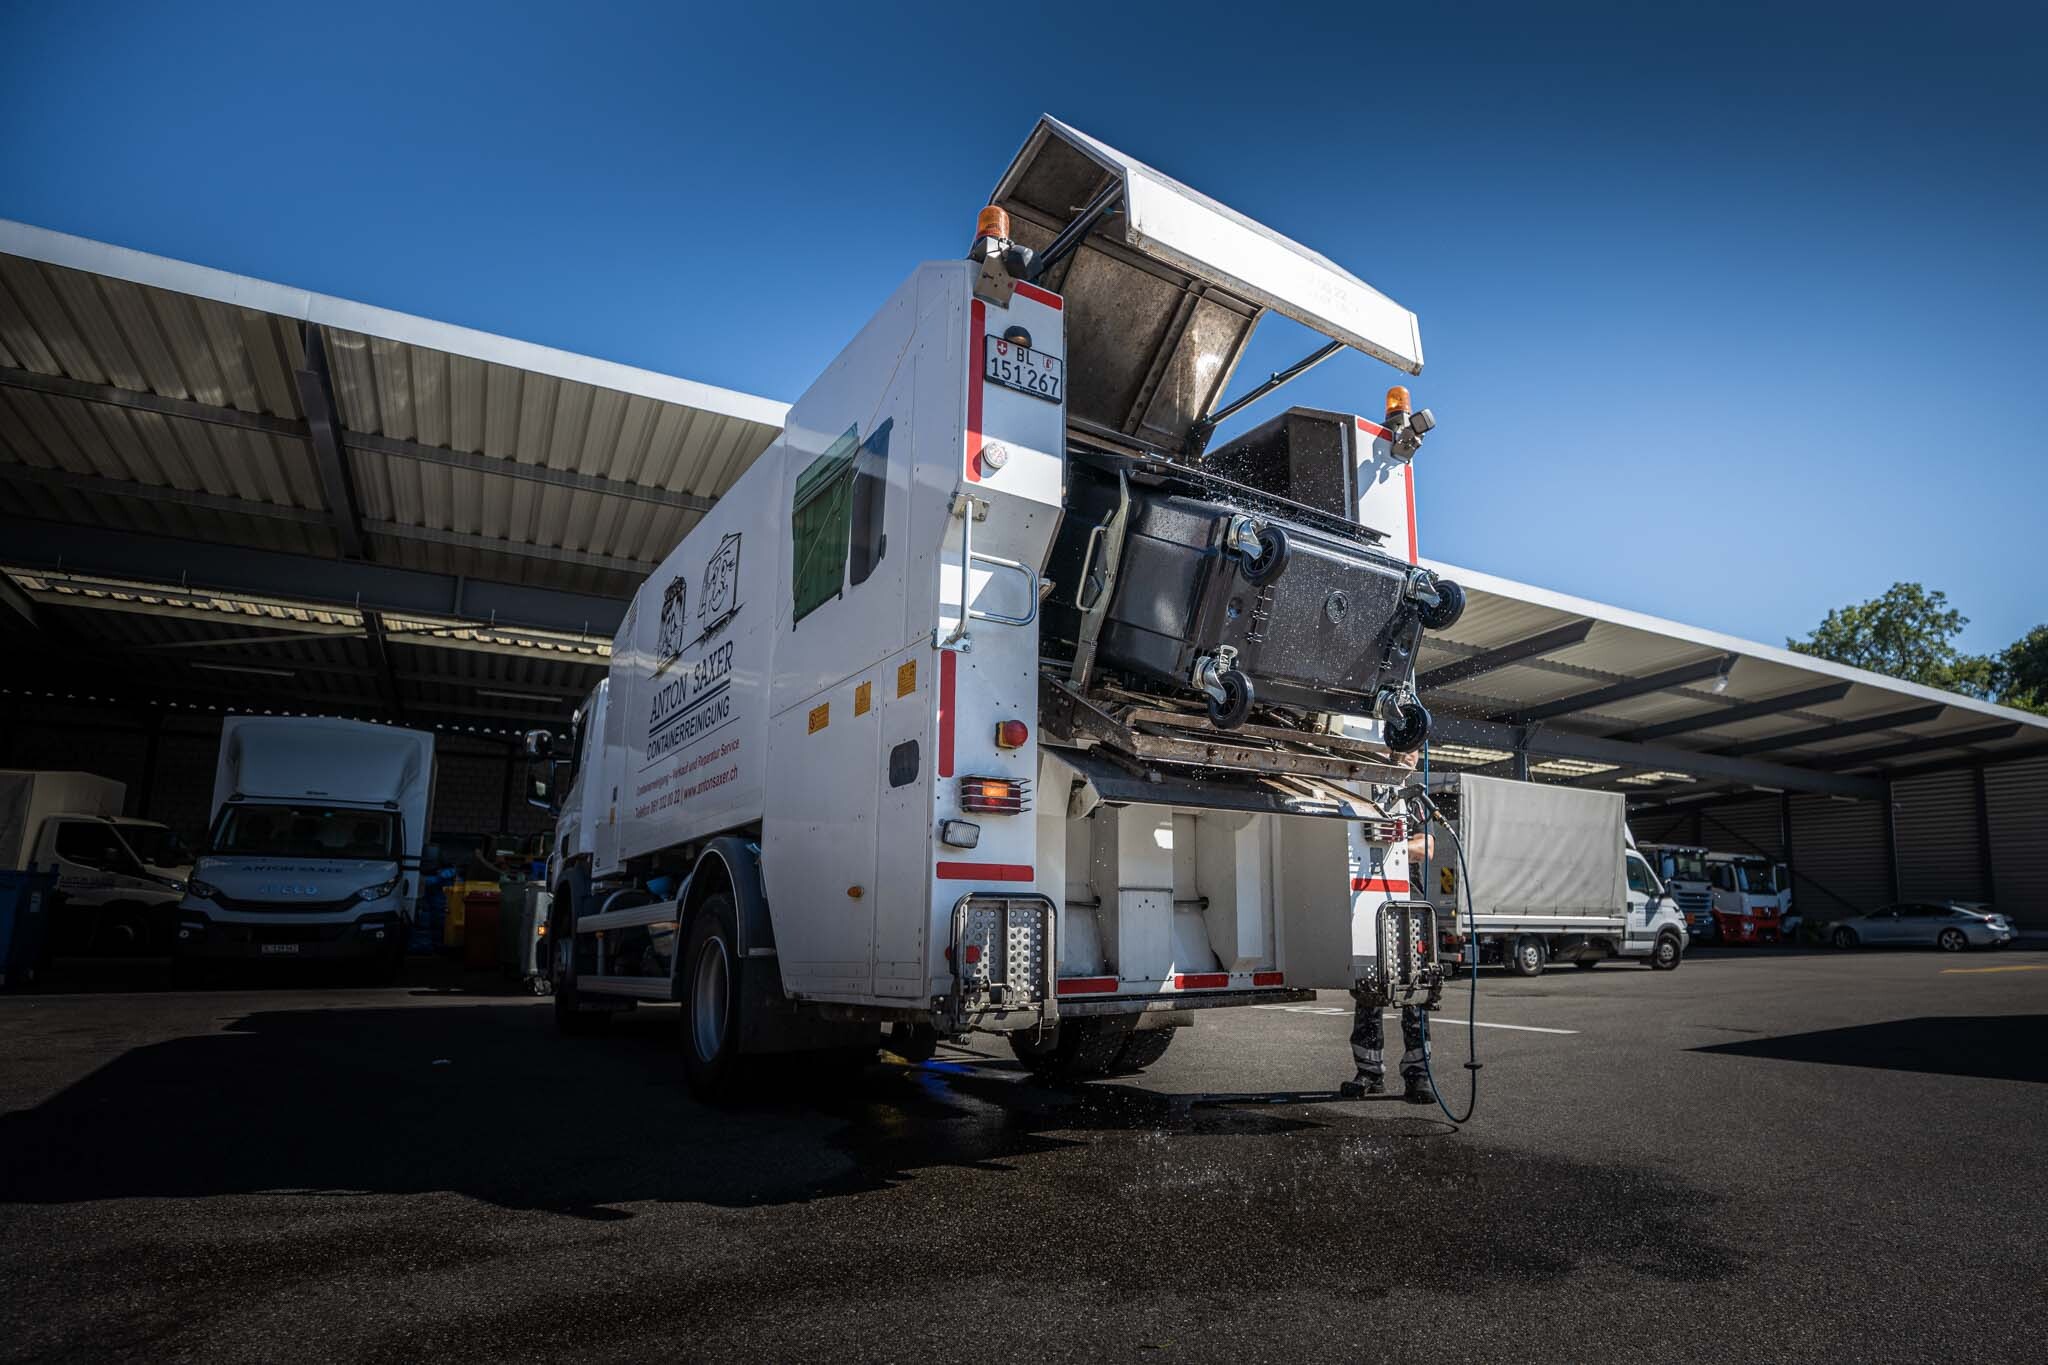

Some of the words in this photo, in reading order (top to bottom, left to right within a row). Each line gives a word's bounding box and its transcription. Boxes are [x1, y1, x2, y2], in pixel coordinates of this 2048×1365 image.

[1016, 347, 1034, 367] BL
[650, 672, 688, 724] ANTON
[692, 640, 734, 694] SAXER
[646, 695, 730, 761] CONTAINERREINIGUNG
[721, 738, 740, 757] Service
[684, 763, 738, 800] www.antonsaxer.ch
